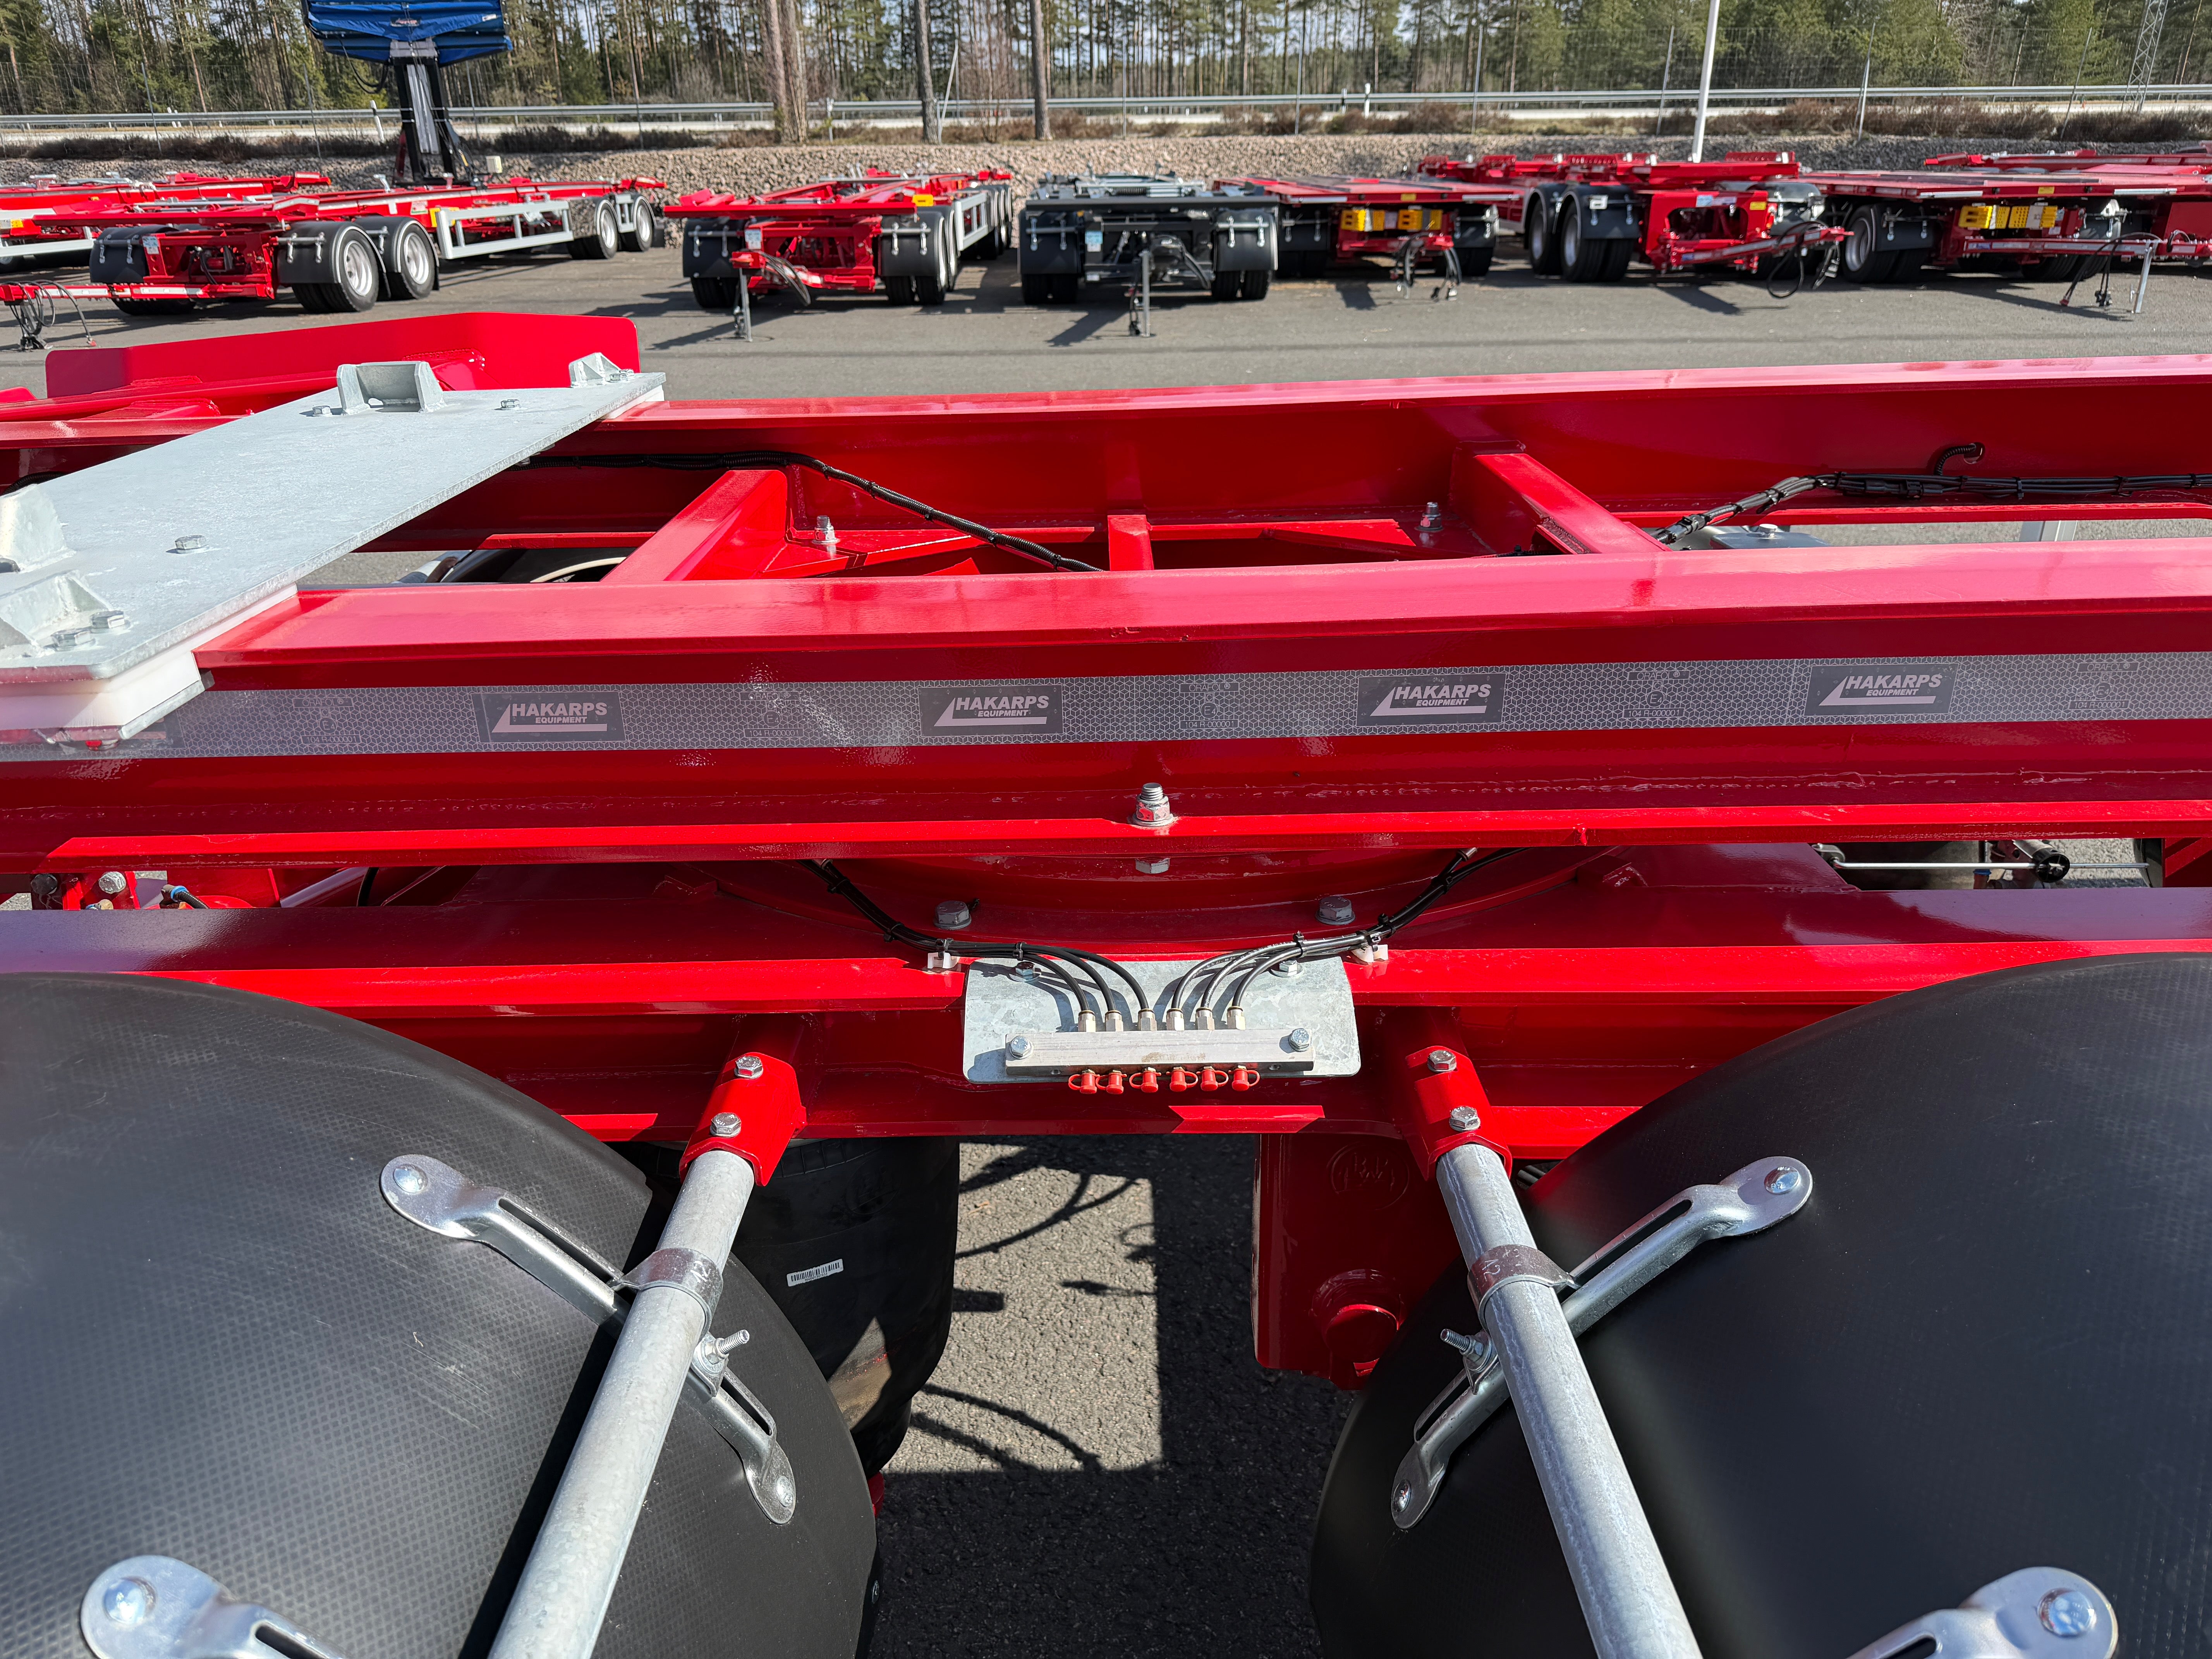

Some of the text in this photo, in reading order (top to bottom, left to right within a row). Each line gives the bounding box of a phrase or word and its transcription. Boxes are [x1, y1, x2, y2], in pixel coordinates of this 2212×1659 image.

[1845, 674, 1942, 689] HAKARPS
[1395, 684, 1491, 699] HAKARPS
[512, 702, 608, 717] HAKARPS
[955, 696, 1049, 710] HAKARPS
